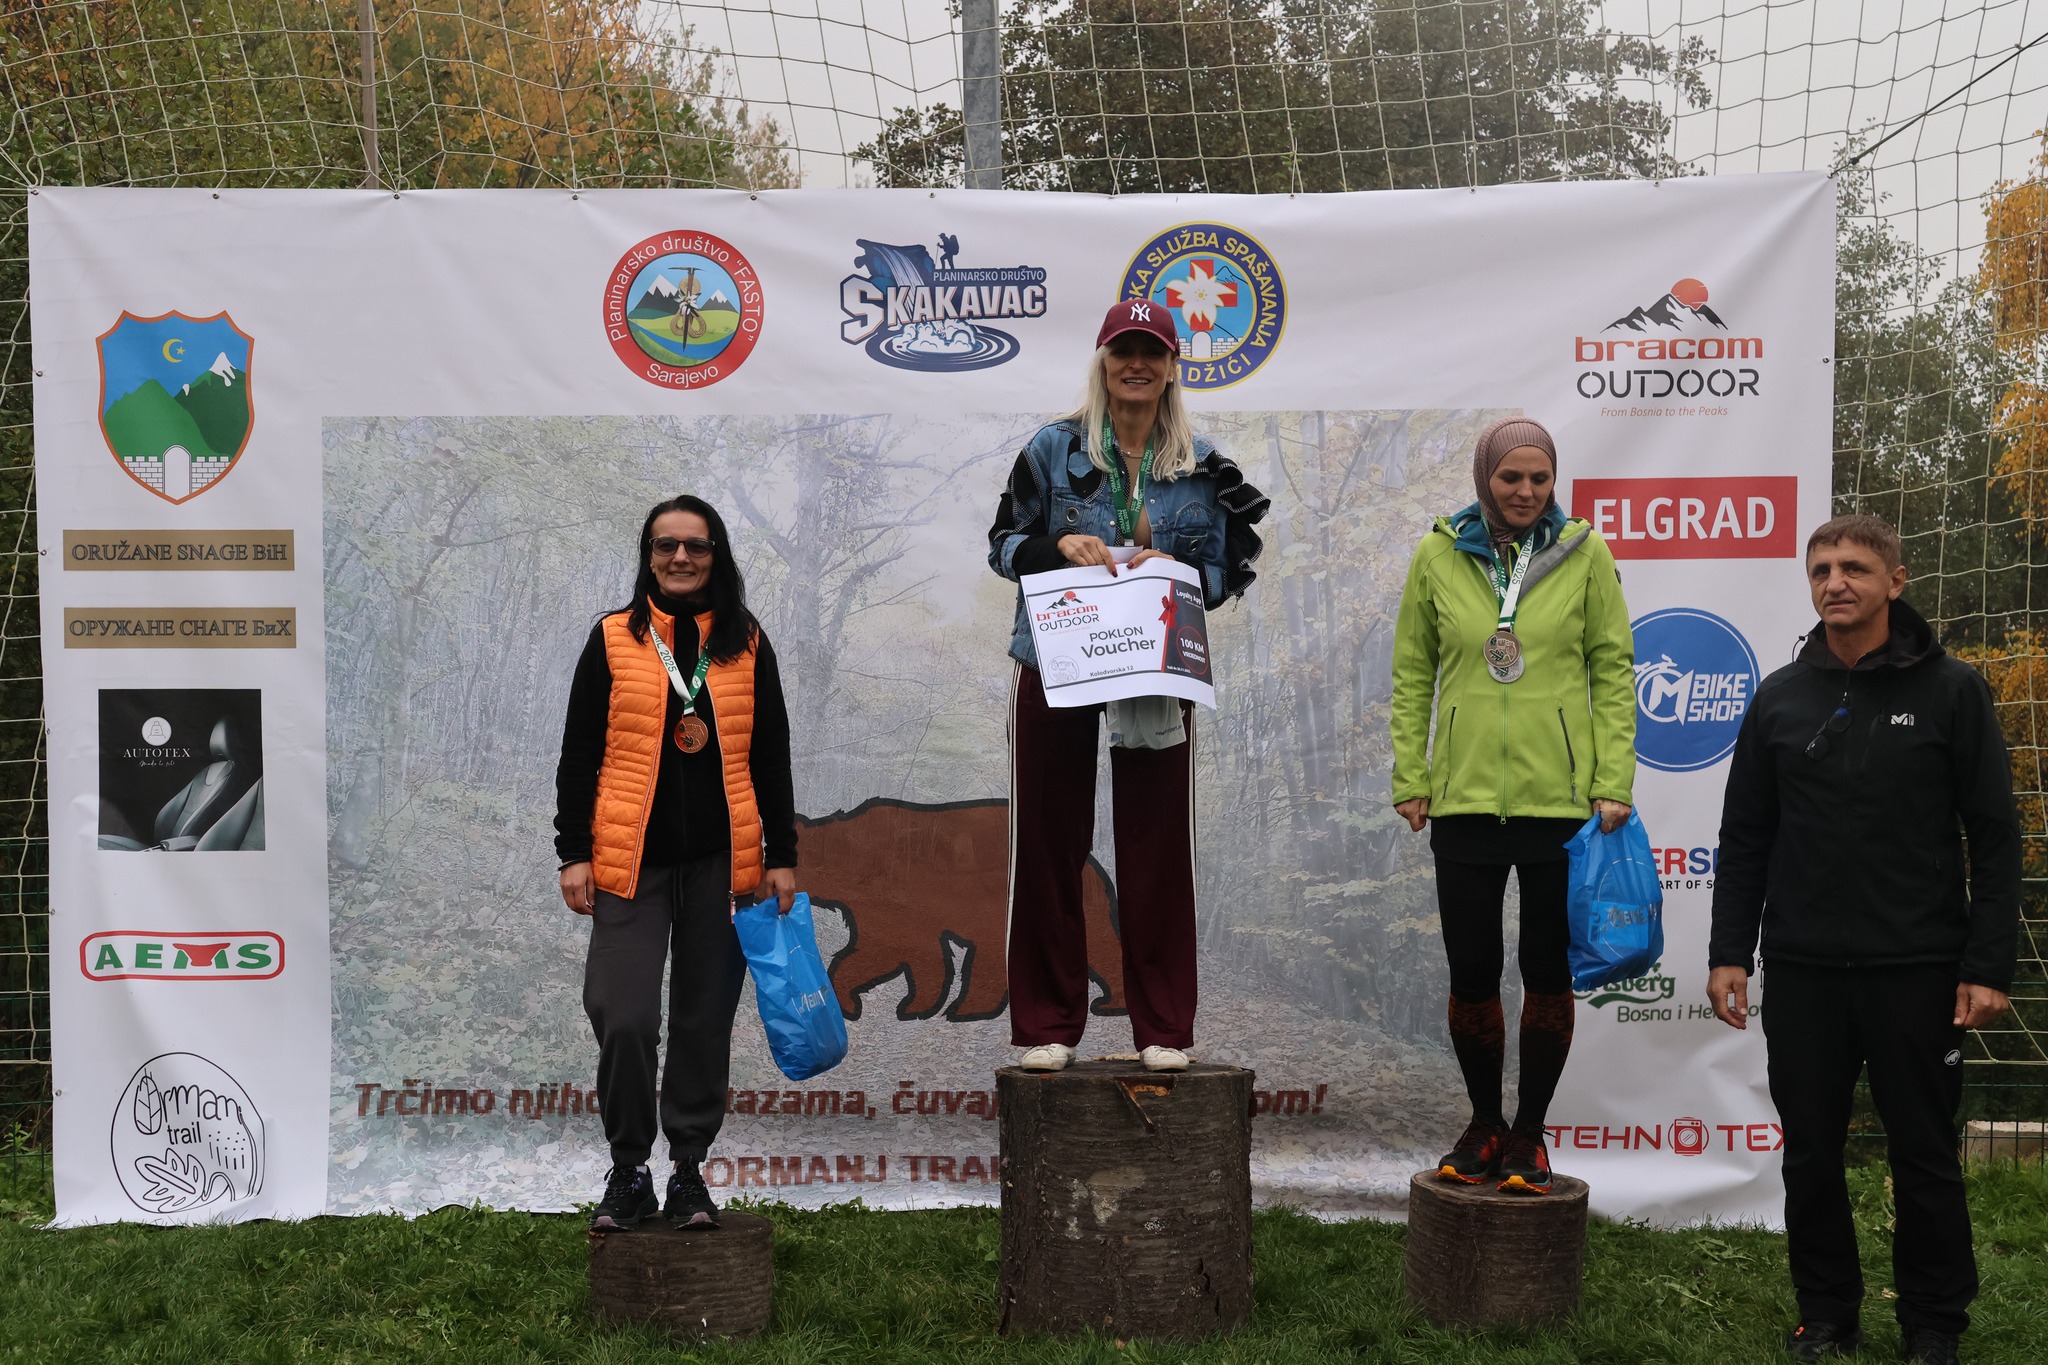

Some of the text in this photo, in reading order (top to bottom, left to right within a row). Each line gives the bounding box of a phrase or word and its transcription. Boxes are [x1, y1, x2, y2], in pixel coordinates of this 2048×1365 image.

[933, 268, 1044, 282] PLANINARSKO DRUŠTVO
[608, 245, 657, 342] Planinarsko
[662, 236, 729, 263] društvo
[1146, 229, 1220, 268] SLUŽBA
[1223, 236, 1277, 349] SPAŠAVANJA
[843, 278, 1046, 342] SKAKAVAC
[1575, 336, 1764, 363] bracom
[646, 362, 719, 388] Sarajevo
[1576, 368, 1760, 399] OUTDOOR
[1601, 406, 1728, 417] From Bosnia to the Peaks
[1594, 497, 1775, 540] ELGRAD
[71, 540, 288, 560] ORUŽANE SNAGE BiH
[1511, 562, 1526, 585] 2025
[1036, 605, 1098, 621] bracom
[1039, 613, 1100, 632] OUTDOOR
[69, 620, 291, 636] ОРУЖАНЕ СНАГЕ БиХ
[1089, 626, 1144, 643] POKLON
[1081, 638, 1156, 658] Voucher
[1180, 637, 1193, 650] 100
[660, 649, 677, 673] 2025
[1090, 667, 1126, 677] Kolodvorska
[1691, 673, 1749, 699] BIKE
[1687, 700, 1745, 722] SHOP
[123, 748, 191, 758] AUTOTEX
[1686, 880, 1702, 889] OF
[94, 943, 272, 970] AEMS
[1617, 1005, 1672, 1023] Bosna
[1677, 1005, 1684, 1020] i
[355, 1079, 496, 1117] Trčimo
[725, 1086, 876, 1121] tazama,
[892, 1080, 1000, 1121] čuvaj
[1250, 1083, 1328, 1117] om!
[167, 1121, 202, 1145] trail
[704, 1154, 1000, 1188] ORMANJ TRAI
